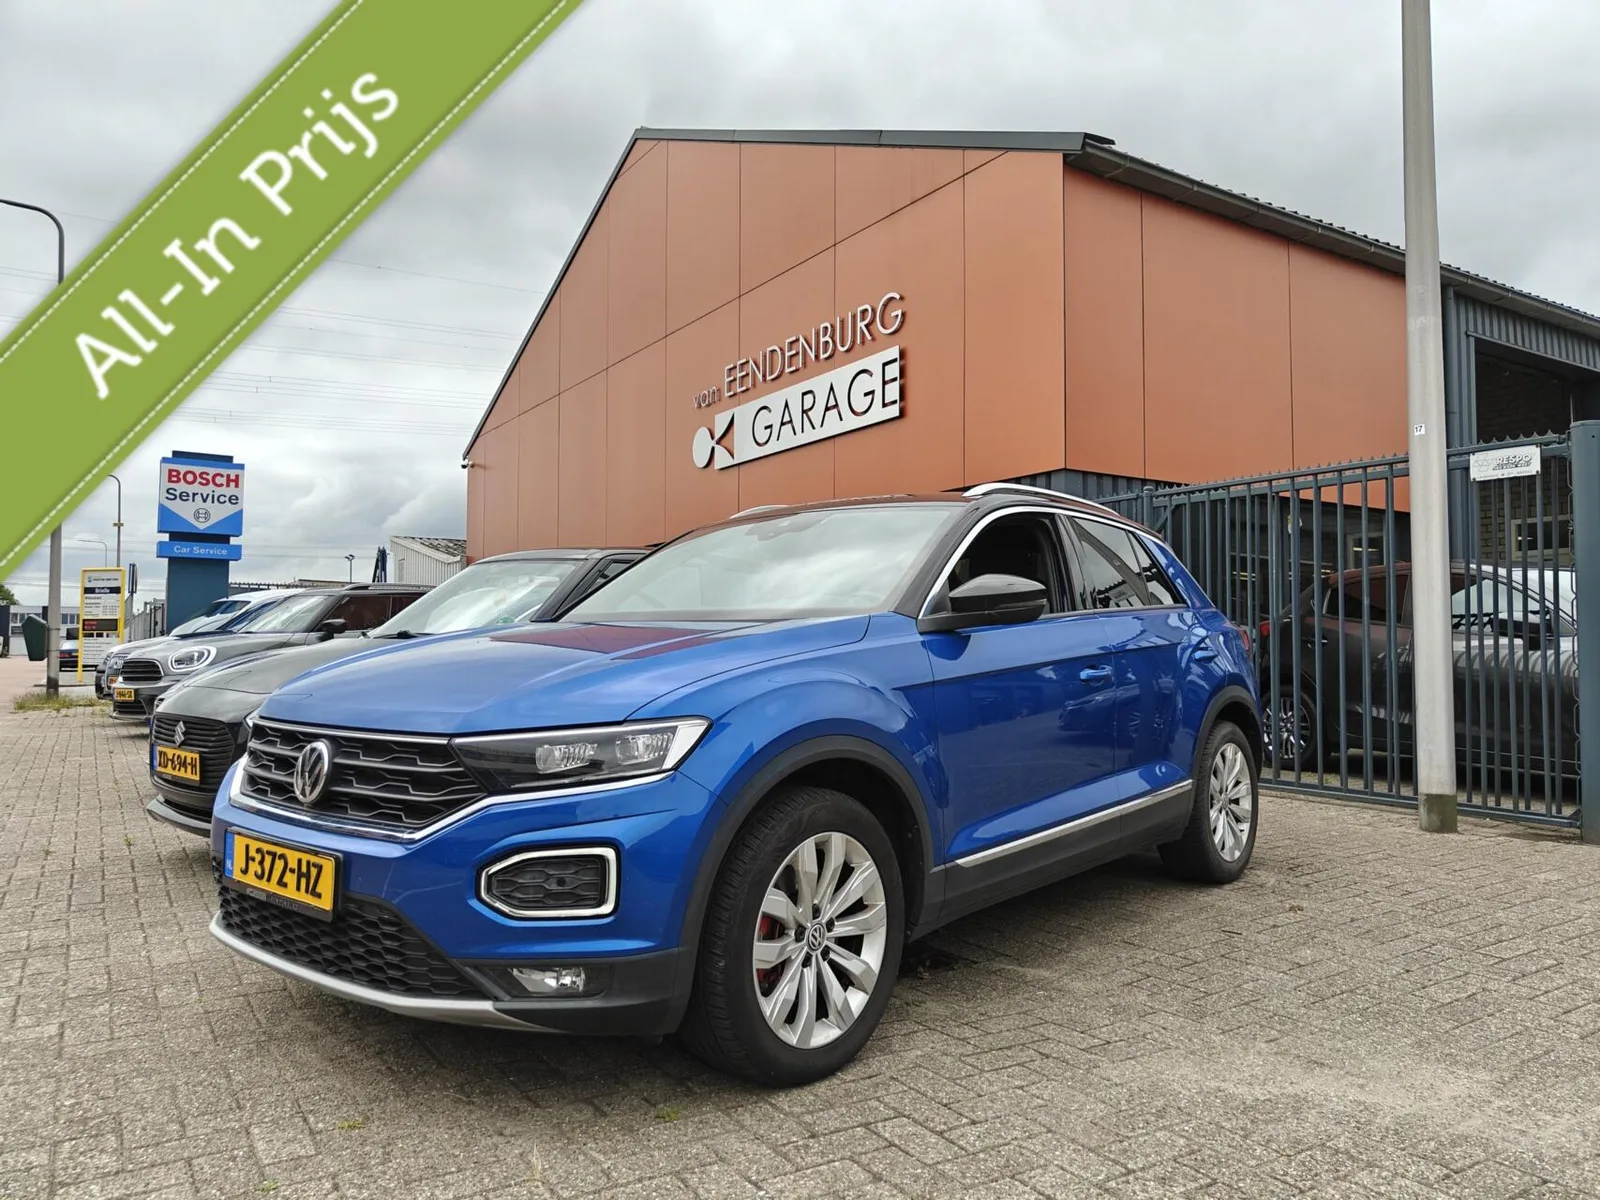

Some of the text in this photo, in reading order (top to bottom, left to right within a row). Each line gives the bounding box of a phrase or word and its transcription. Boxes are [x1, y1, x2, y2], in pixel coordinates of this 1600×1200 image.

[692, 291, 904, 409] van EENDENBURG
[751, 356, 899, 448] GARAGE
[1414, 425, 1423, 433] 17
[167, 468, 240, 489] BOSCH
[164, 487, 240, 506] Service
[173, 545, 228, 556] Car Service
[240, 843, 324, 900] J-372-HZ
